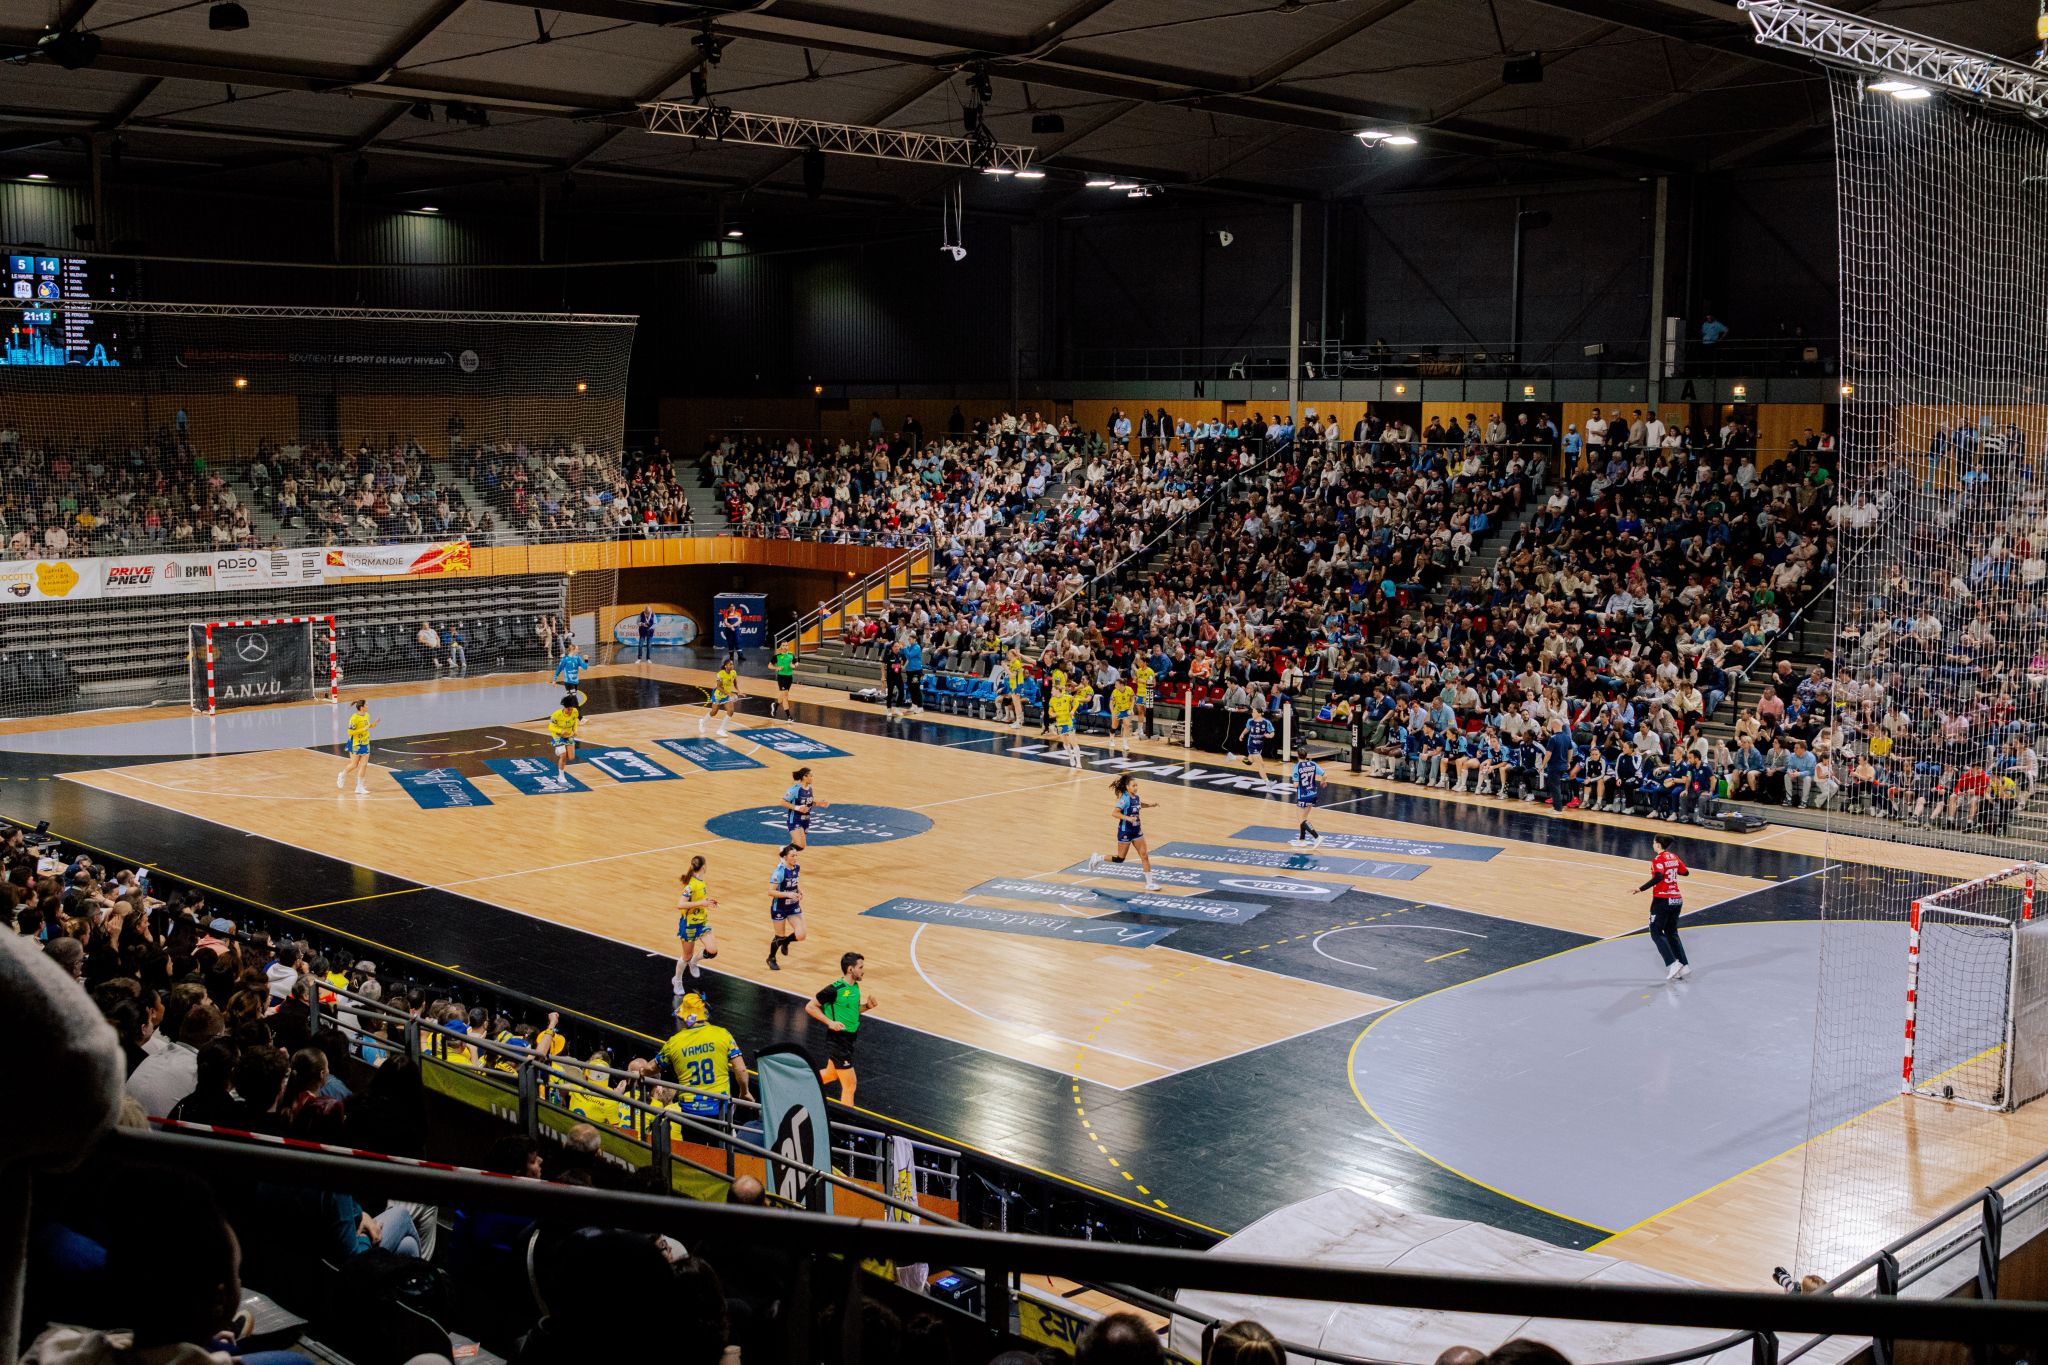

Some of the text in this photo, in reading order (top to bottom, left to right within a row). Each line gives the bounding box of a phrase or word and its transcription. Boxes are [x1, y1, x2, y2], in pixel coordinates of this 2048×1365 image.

[18, 260, 25, 270] 5
[41, 261, 55, 271] 14
[24, 312, 50, 320] 21:13
[334, 355, 344, 363] LE
[346, 355, 374, 364] SPORT
[389, 356, 413, 365] HAUT
[414, 357, 446, 365] NIVEAU
[1681, 380, 1696, 400] A
[110, 566, 154, 576] DRIVE
[186, 566, 212, 577] BPMI
[106, 575, 150, 585] PNEU
[1088, 757, 1298, 794] HAVRE
[1300, 772, 1315, 786] 27
[1169, 852, 1249, 865] PARISIEN
[991, 884, 1083, 899] Butagaz
[1126, 898, 1223, 914] Butagaz
[681, 1042, 715, 1058] VAMOS
[687, 1058, 715, 1086] 38
